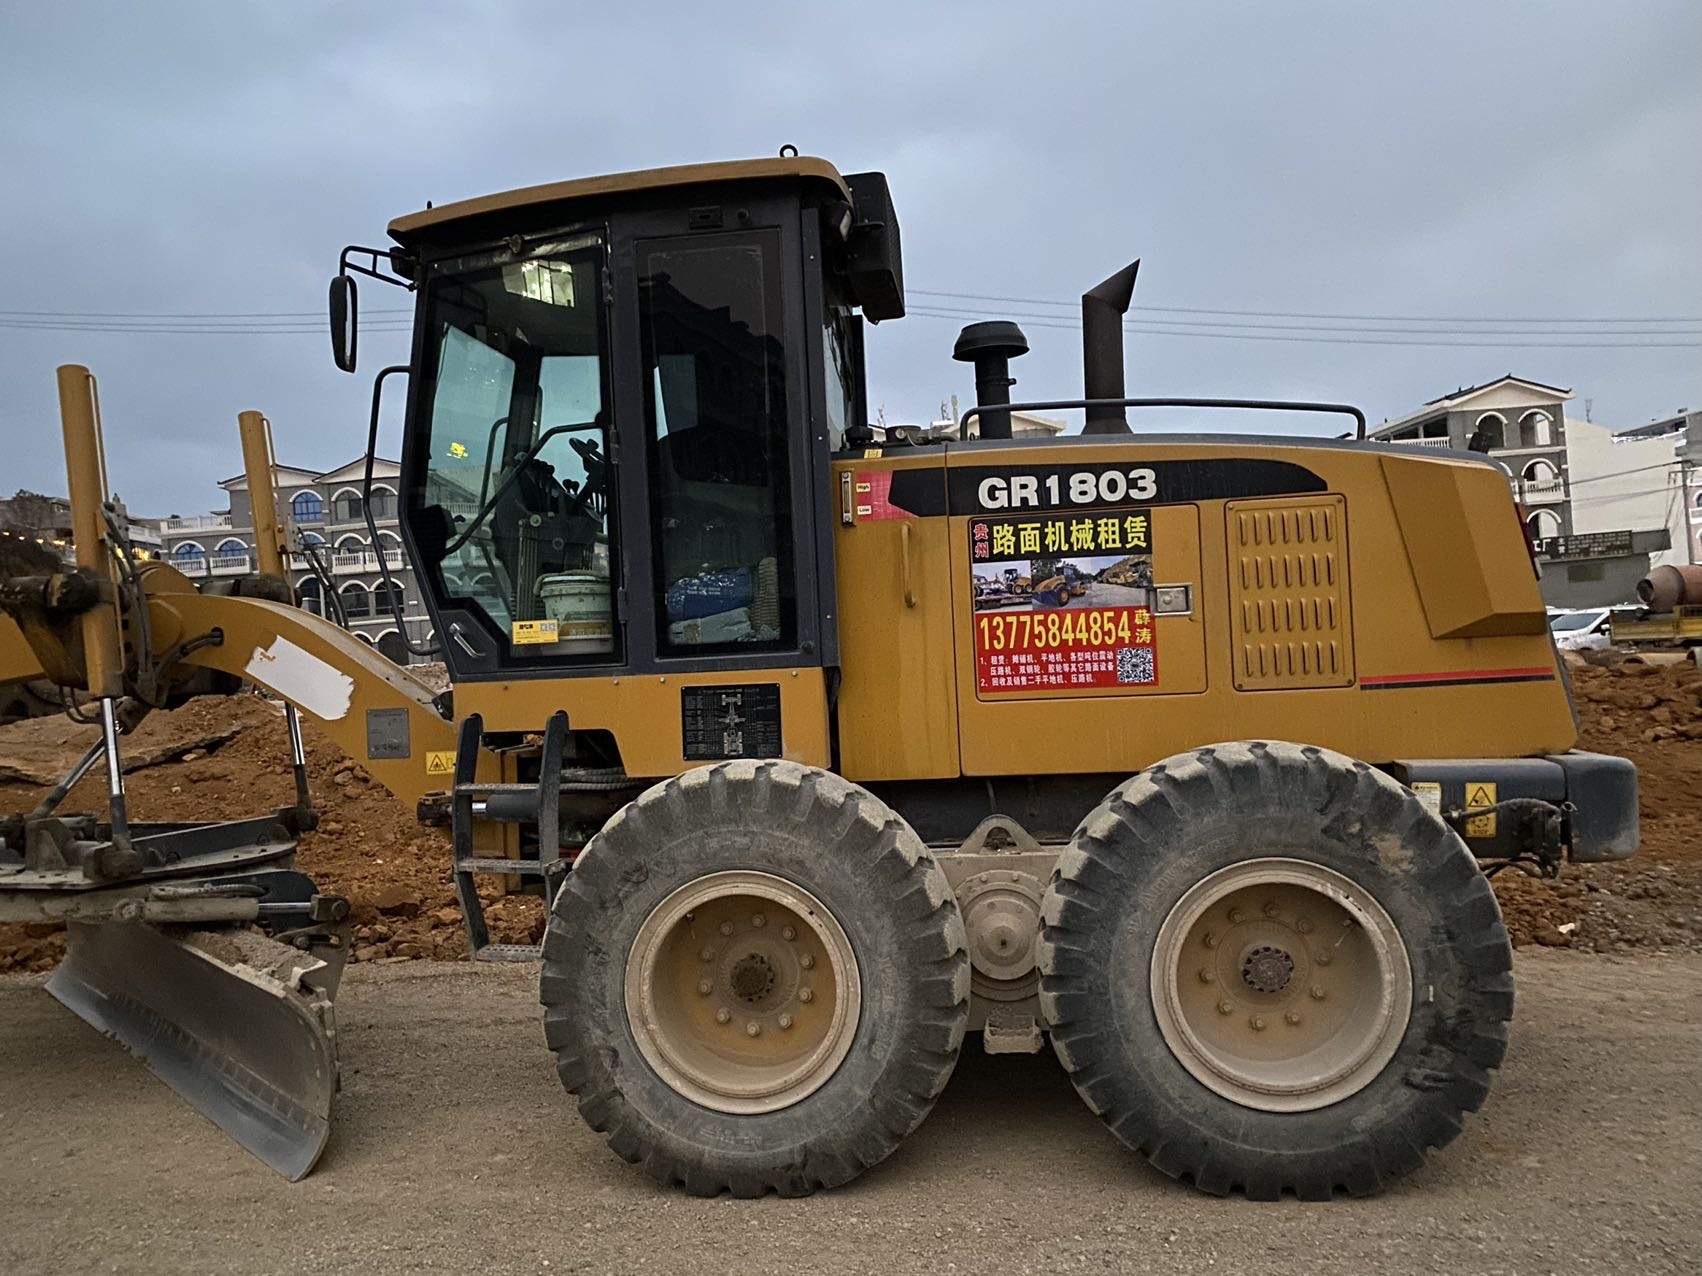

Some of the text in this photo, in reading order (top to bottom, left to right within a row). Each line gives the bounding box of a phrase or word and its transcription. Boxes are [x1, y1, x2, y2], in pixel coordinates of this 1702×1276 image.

[978, 469, 1157, 509] GR1803
[974, 523, 989, 558] 贵州
[992, 516, 1147, 555] 路面机械租赁
[980, 611, 1131, 650] 13775844854
